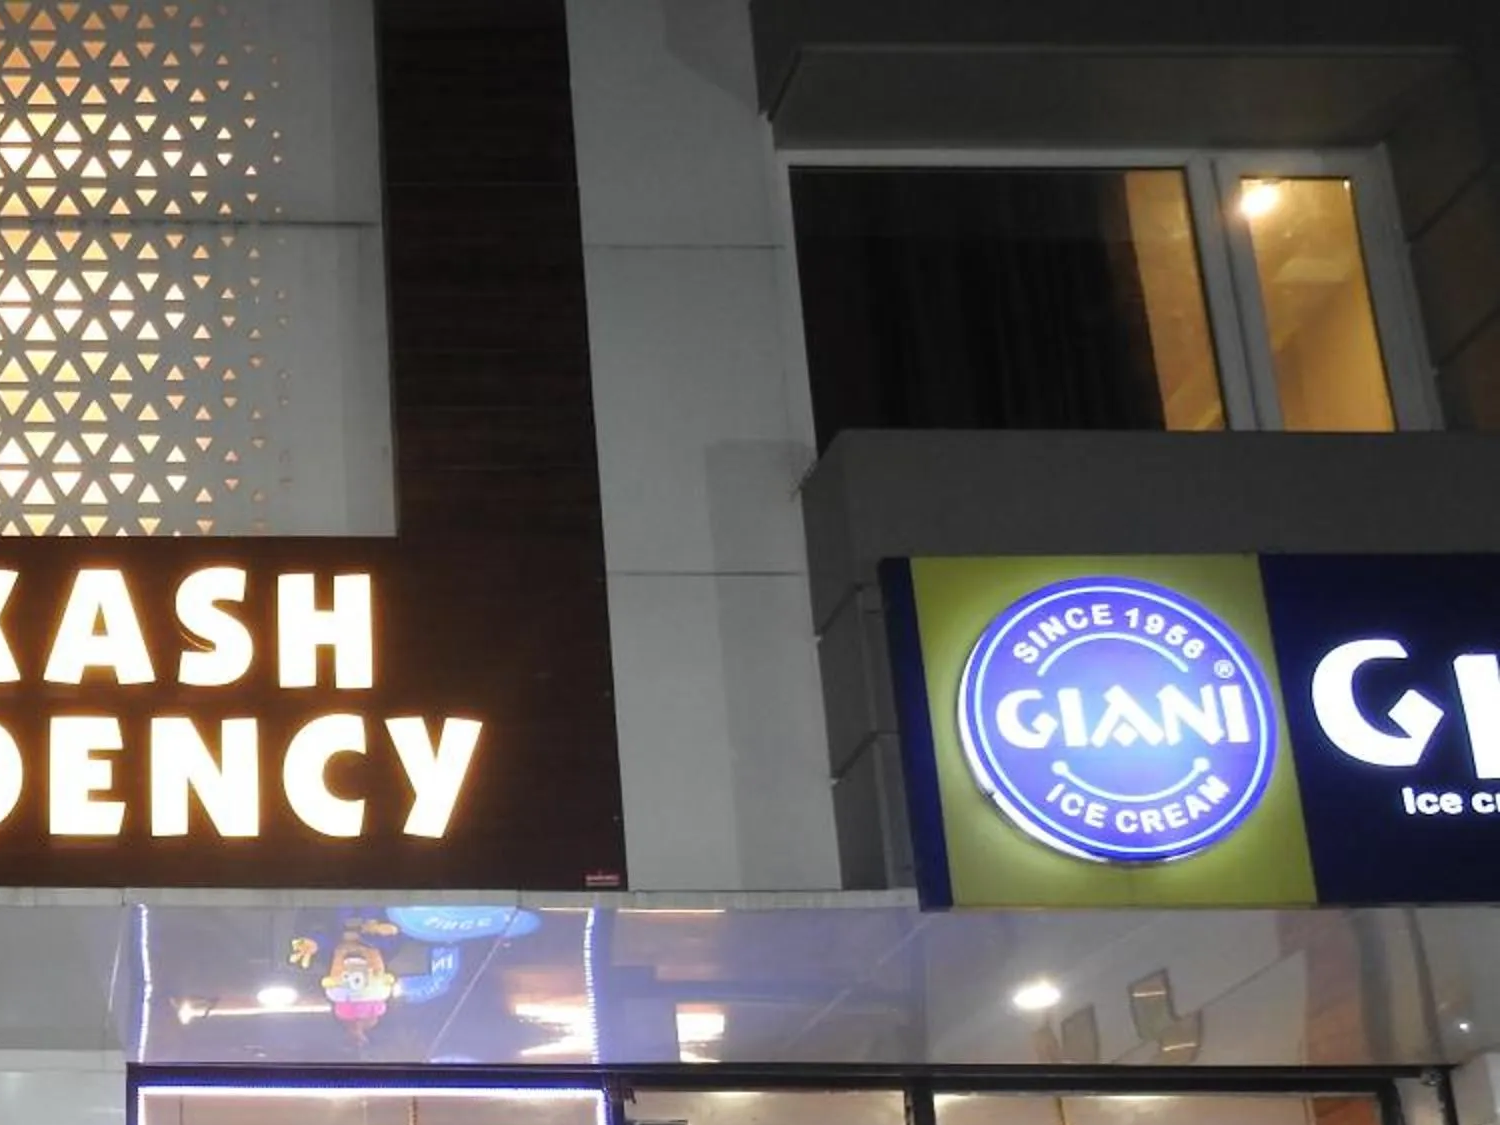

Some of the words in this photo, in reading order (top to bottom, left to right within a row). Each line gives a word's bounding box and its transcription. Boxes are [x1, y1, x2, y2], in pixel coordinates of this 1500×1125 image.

[1012, 603, 1114, 664] SINCE
[1123, 607, 1206, 660] 1956
[994, 683, 1252, 750] GIANI
[1045, 783, 1109, 829] ICE
[1114, 774, 1231, 834] CREAM
[1401, 786, 1464, 815] Ice
